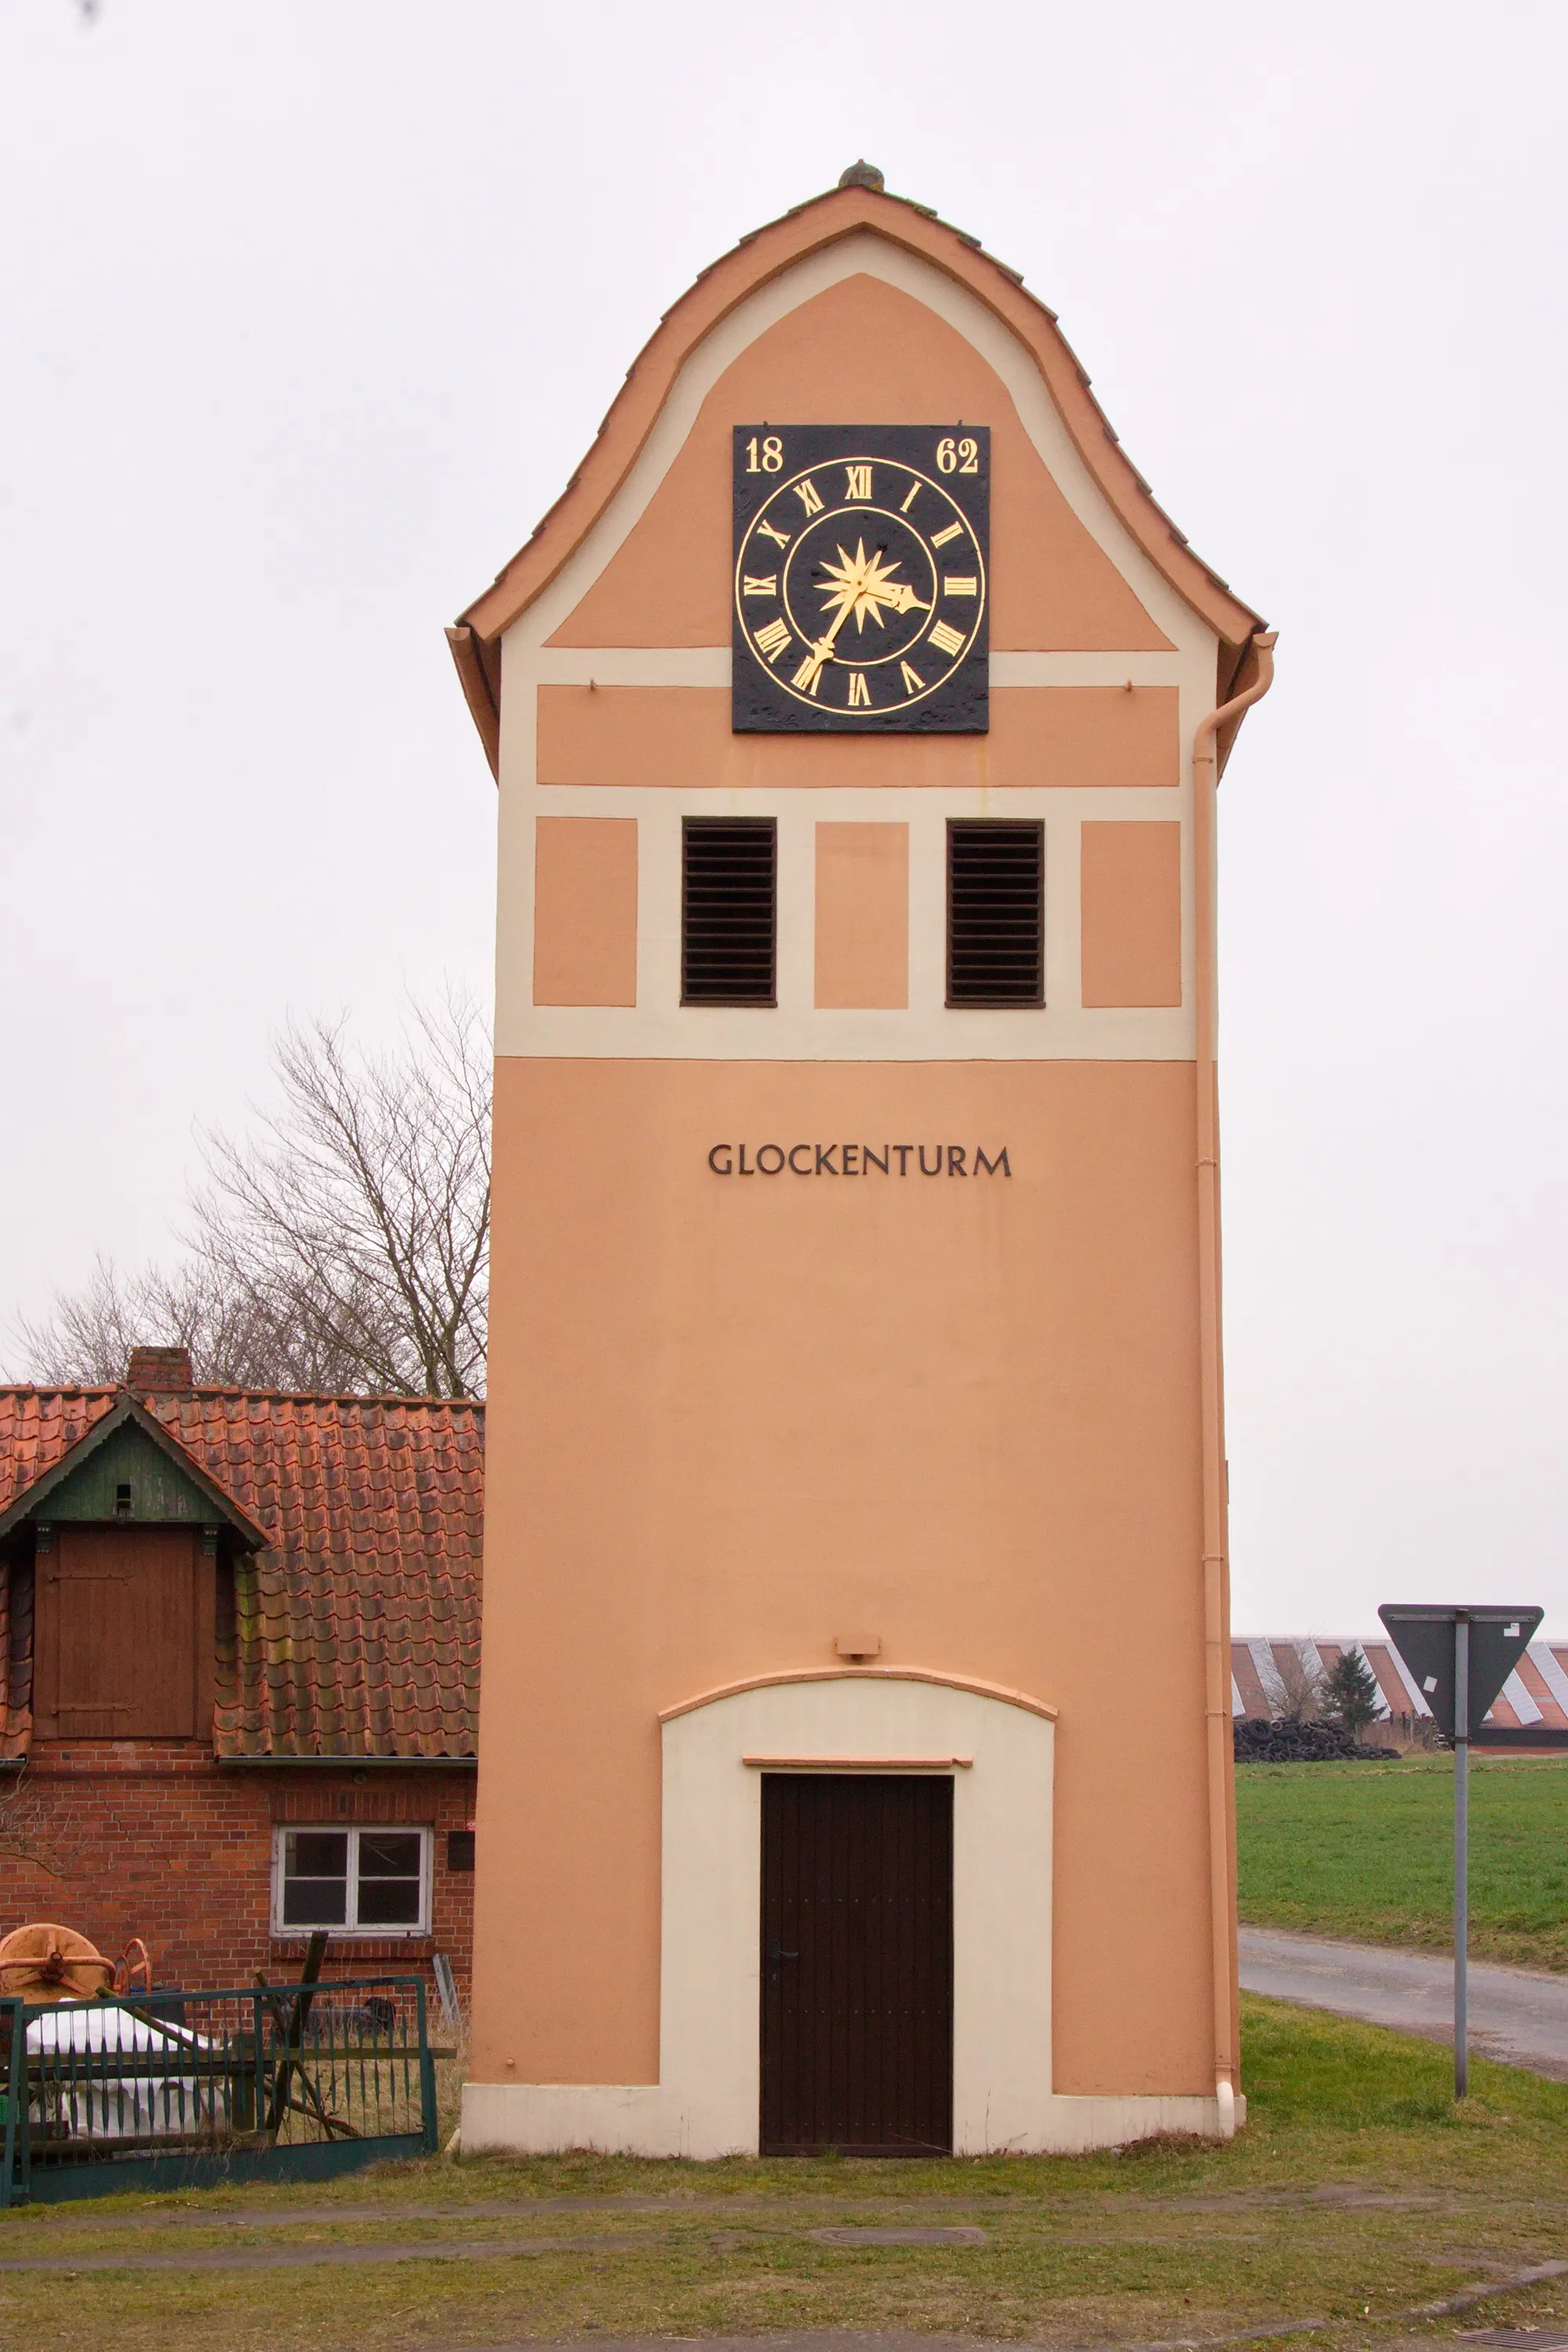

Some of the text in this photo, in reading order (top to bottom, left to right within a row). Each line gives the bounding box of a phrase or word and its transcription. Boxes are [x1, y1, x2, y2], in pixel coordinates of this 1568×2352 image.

[746, 437, 782, 472] 18
[937, 437, 978, 473] 62
[793, 479, 825, 517] XI
[844, 466, 873, 499] XII
[900, 481, 922, 513] I
[757, 519, 790, 549] X
[931, 521, 964, 549] II
[744, 575, 776, 596] IX
[944, 575, 977, 596] III
[847, 673, 872, 706] VI
[900, 661, 926, 694] V
[708, 1144, 1011, 1177] GLOCKENTURM
